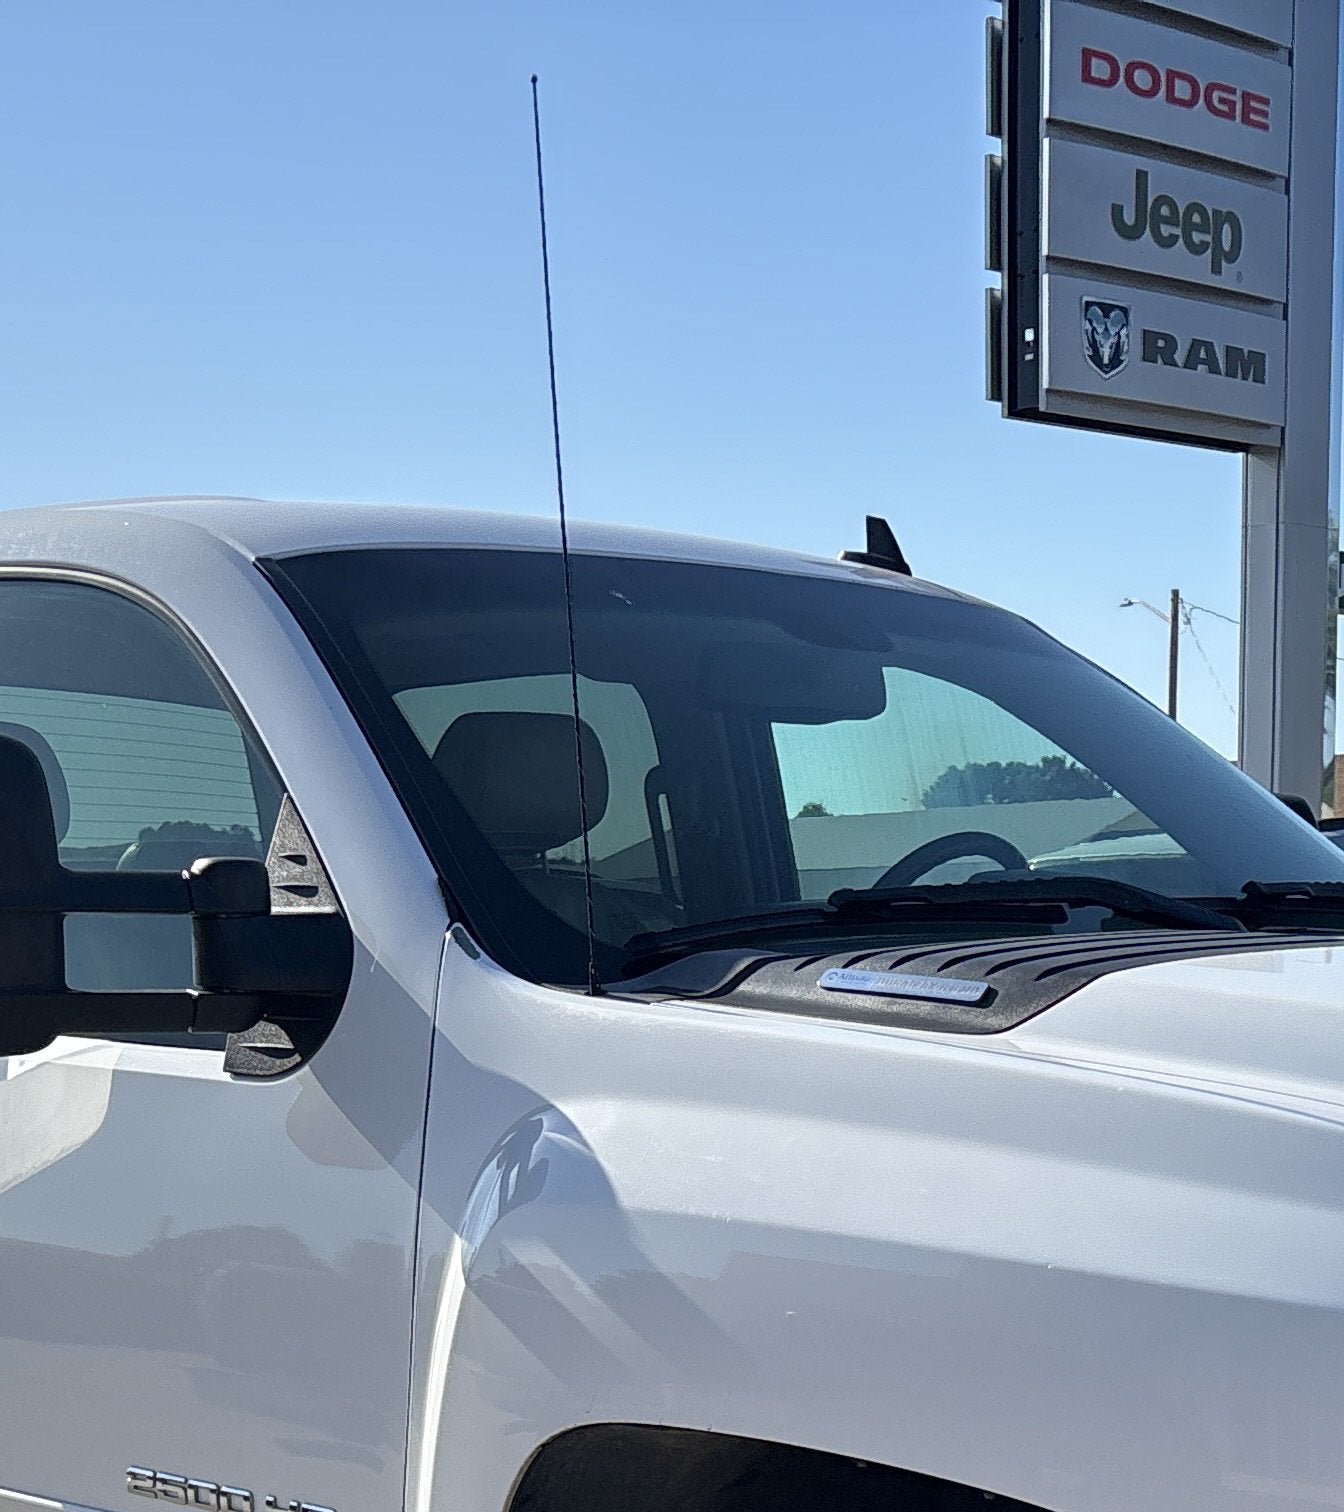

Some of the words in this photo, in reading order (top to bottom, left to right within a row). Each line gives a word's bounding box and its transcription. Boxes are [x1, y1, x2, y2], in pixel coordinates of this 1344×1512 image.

[1080, 46, 1271, 132] DODGE
[1110, 168, 1243, 276] Jeep
[1140, 328, 1268, 385] RAM
